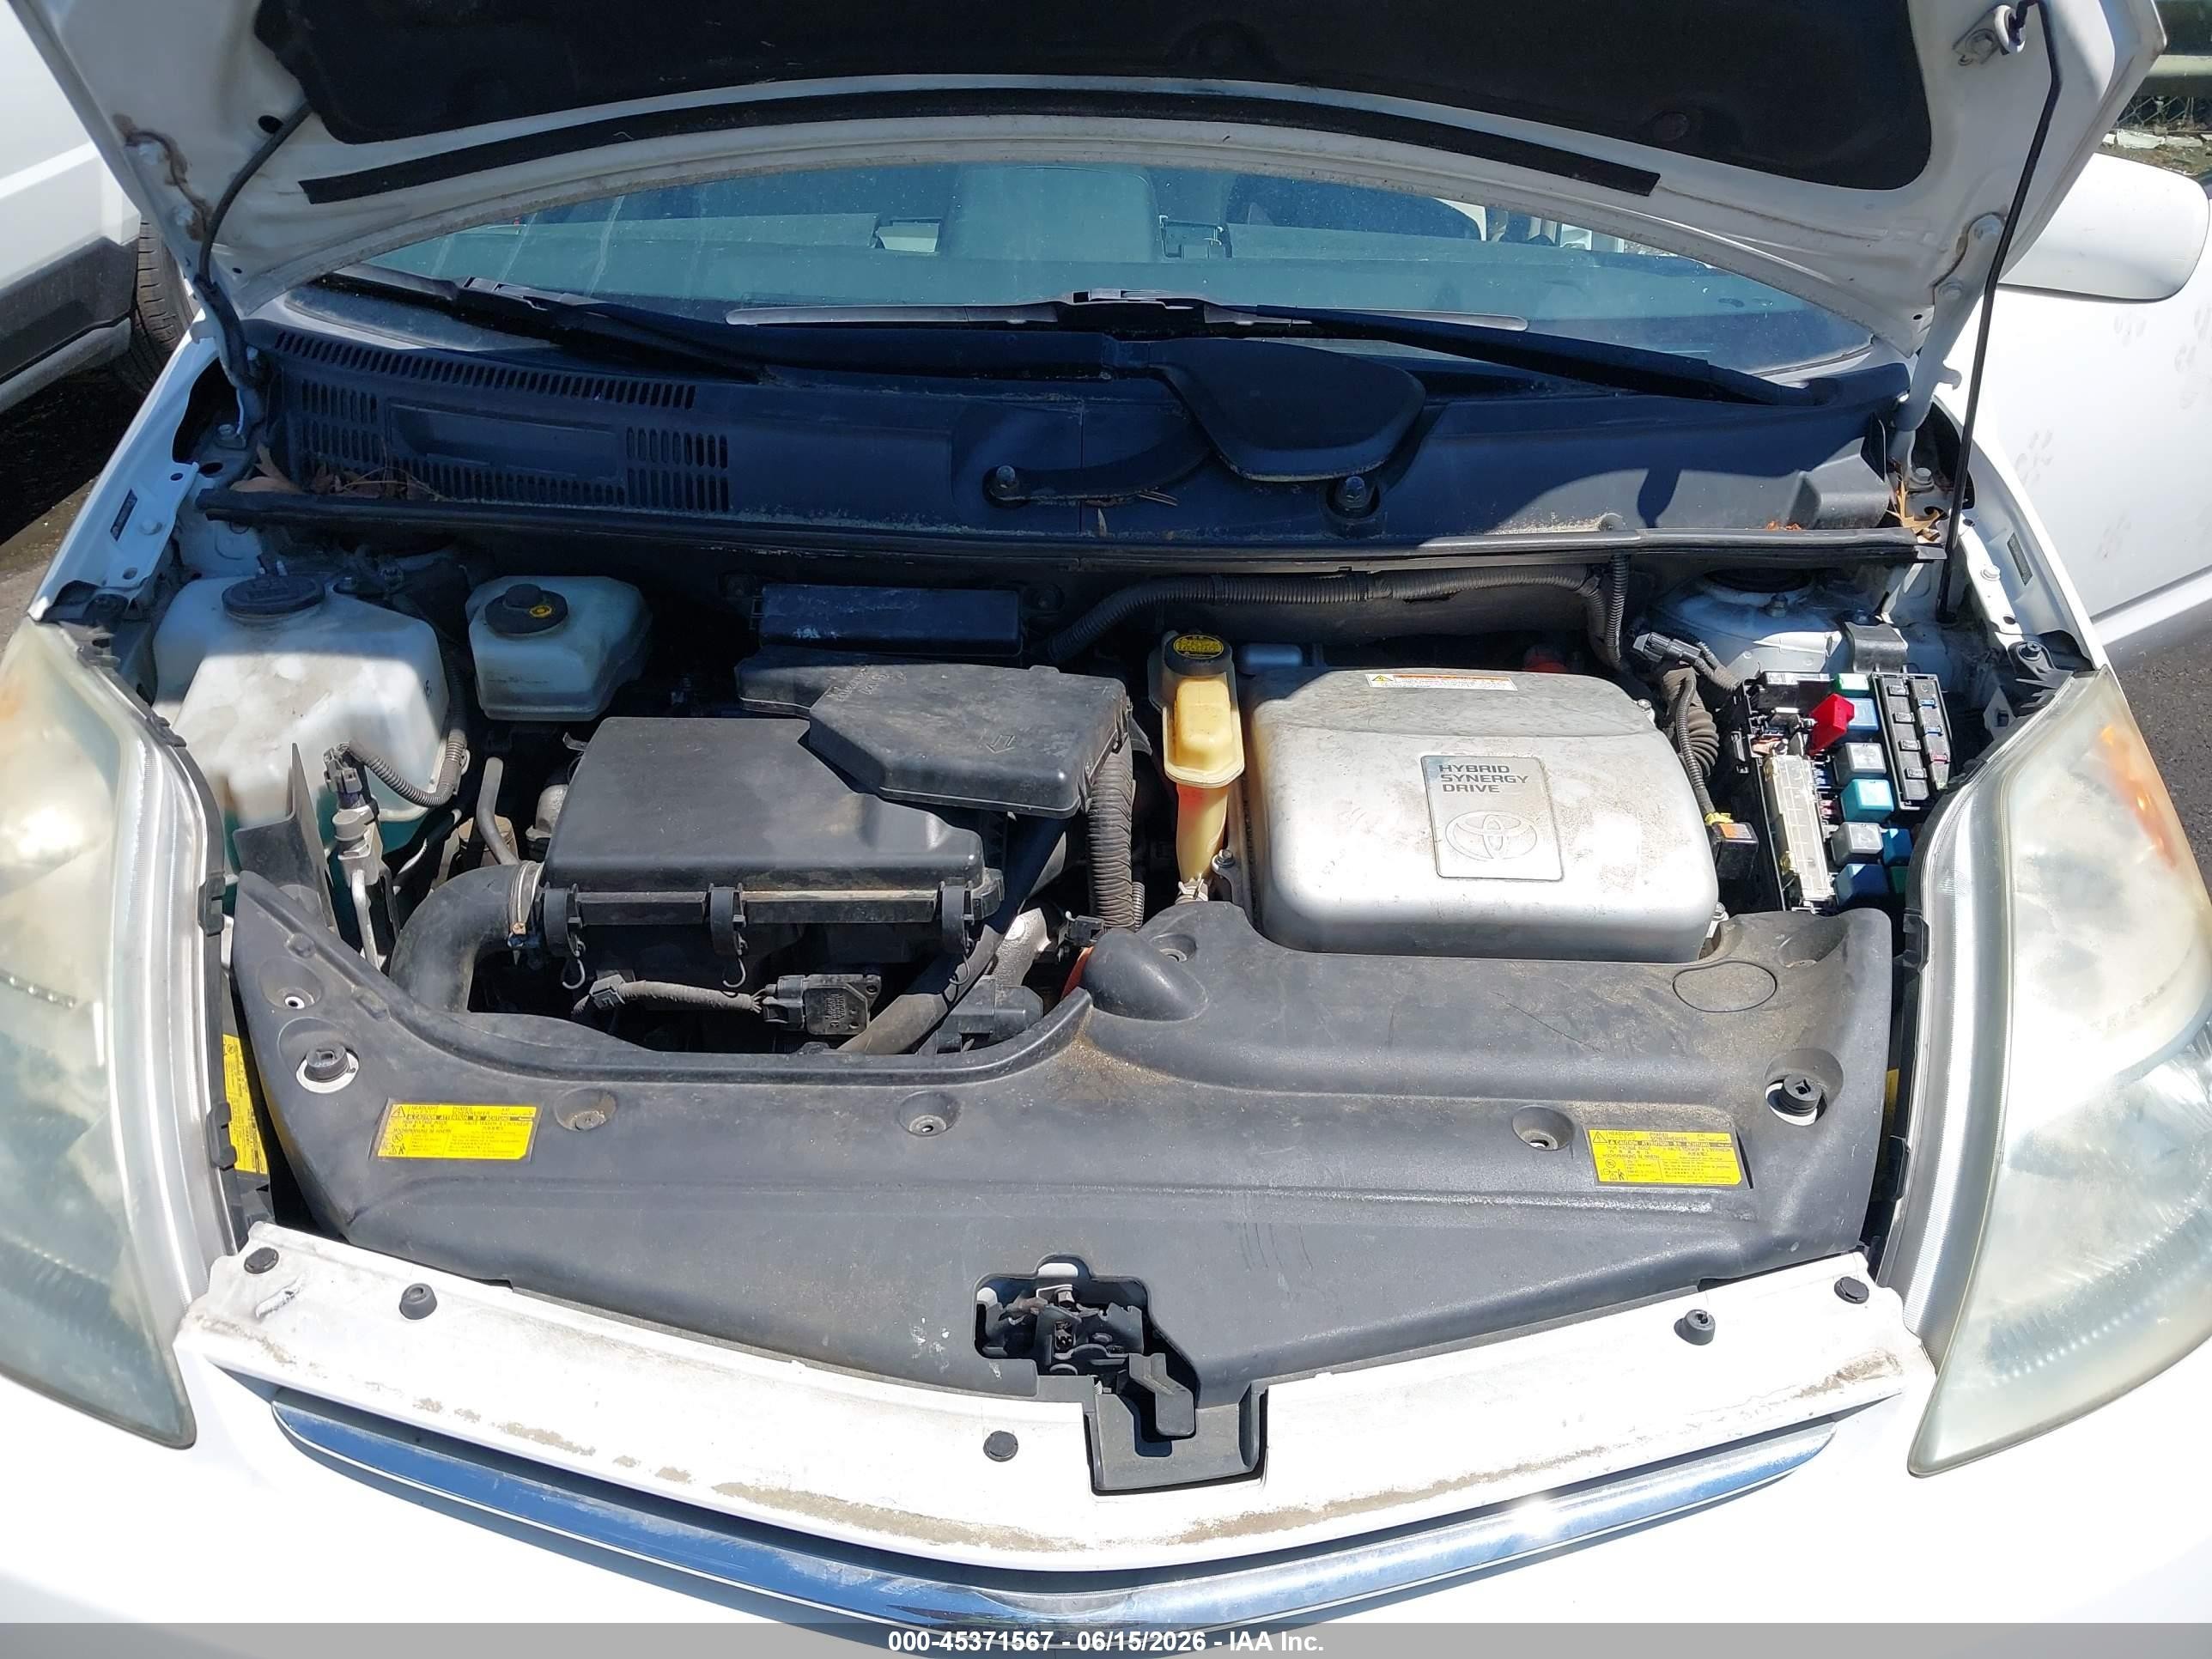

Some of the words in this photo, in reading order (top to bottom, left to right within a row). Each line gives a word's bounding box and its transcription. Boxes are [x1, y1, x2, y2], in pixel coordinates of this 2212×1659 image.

[1438, 764, 1510, 773] HYBRID
[1441, 775, 1528, 783] SYNERGY
[1443, 784, 1500, 793] DRIVE
